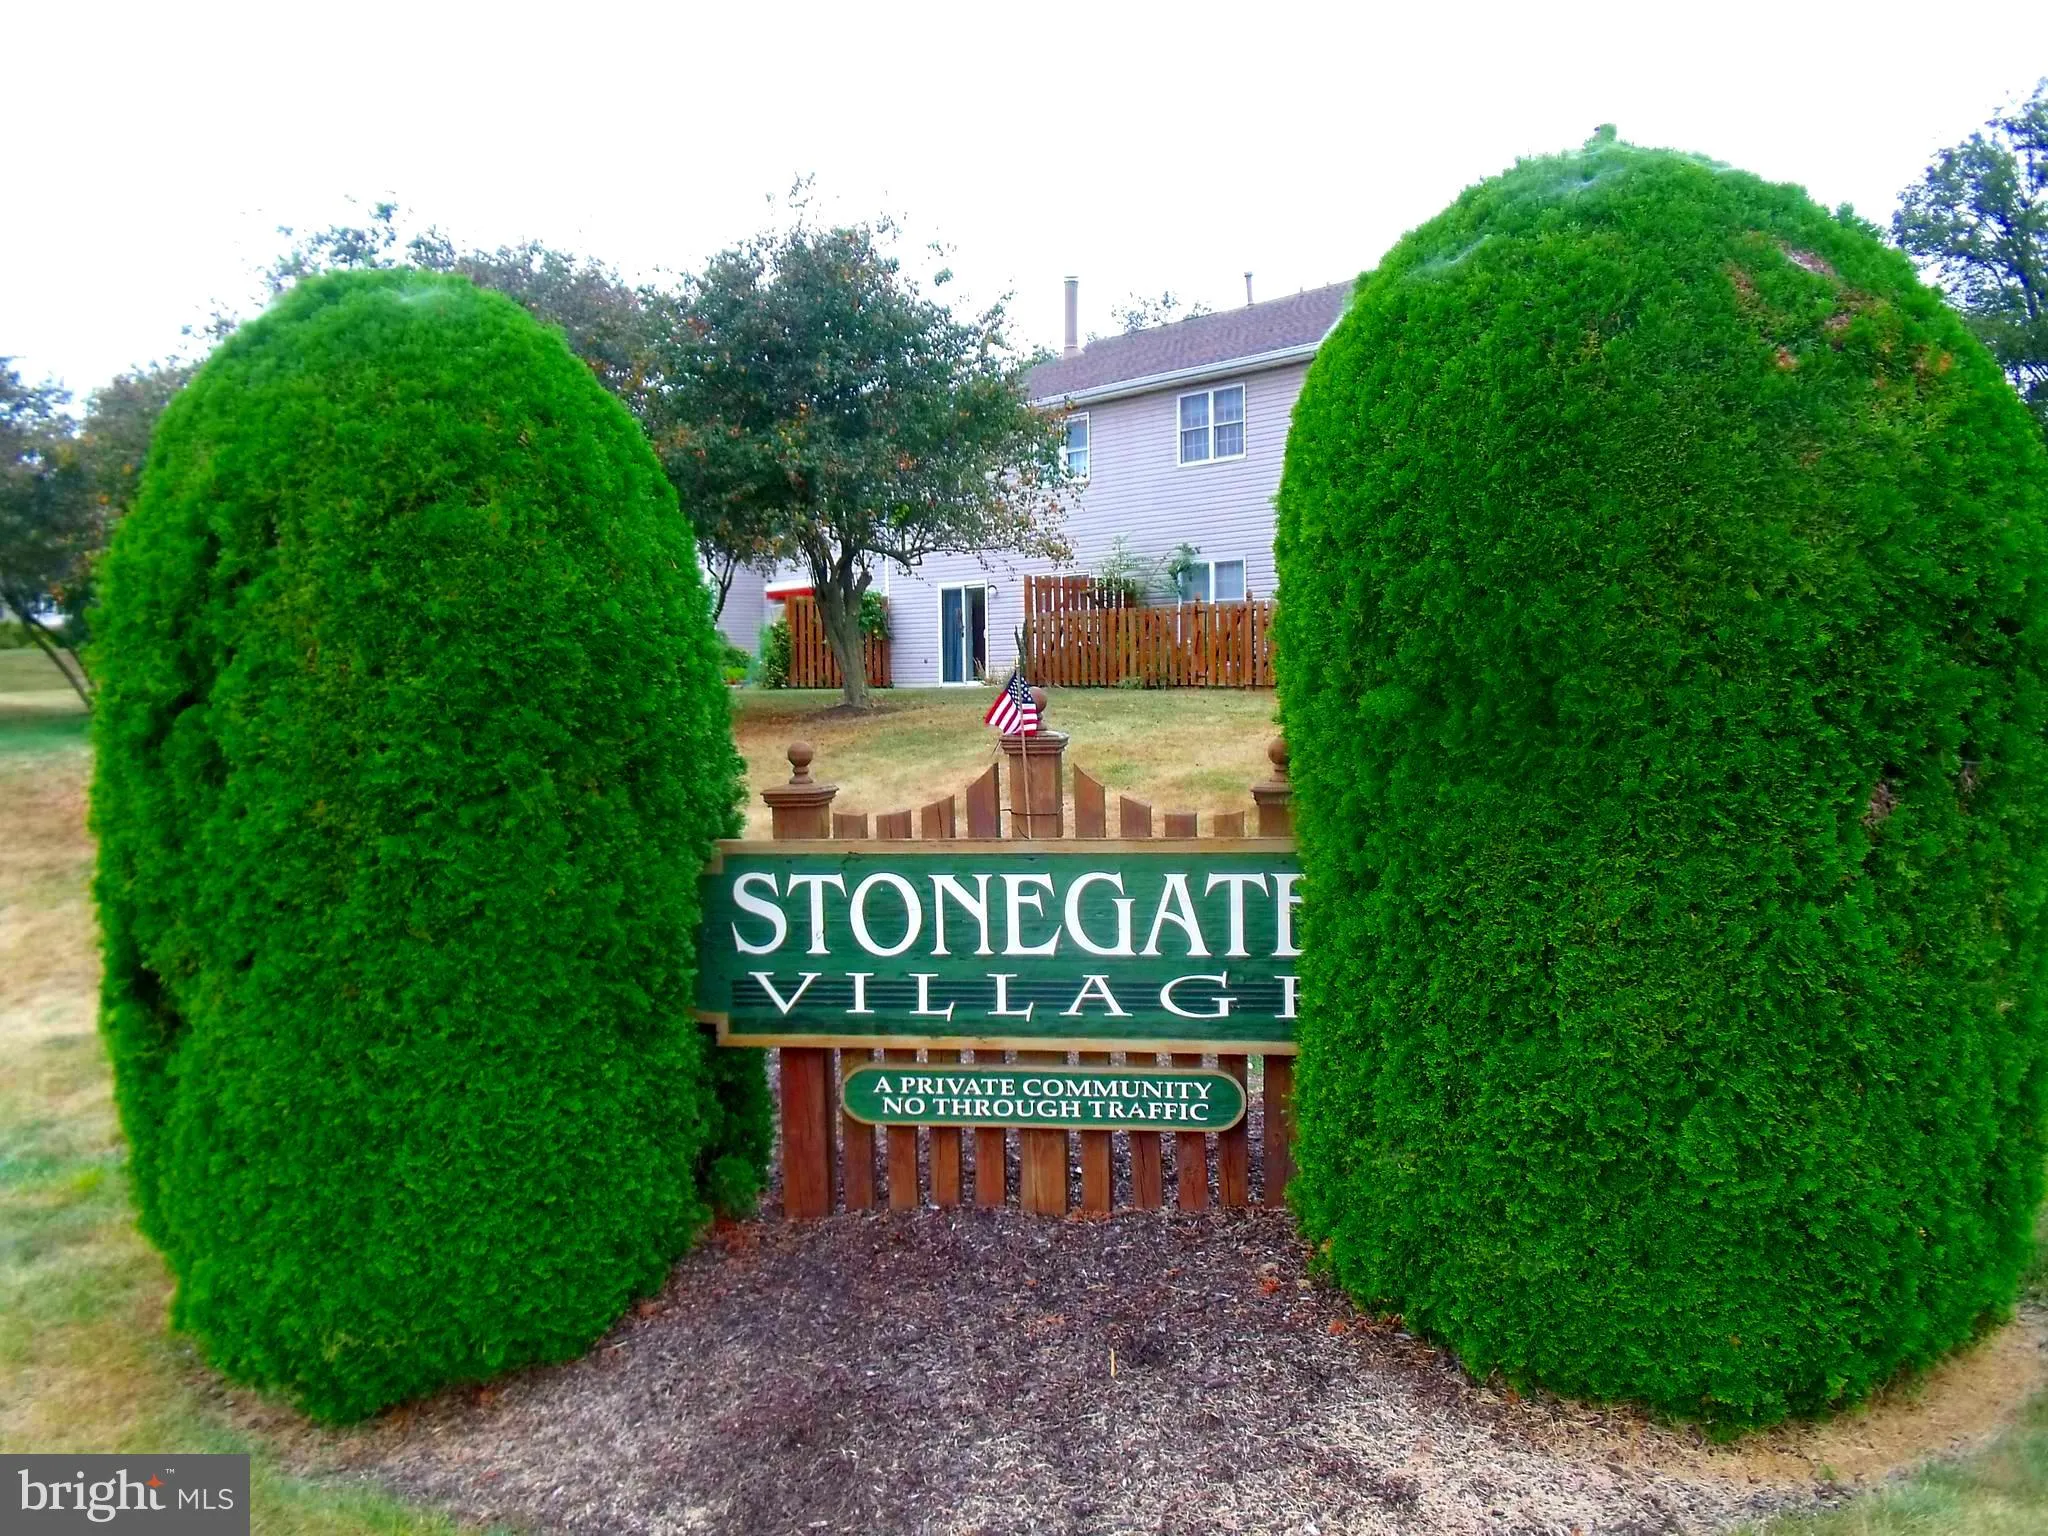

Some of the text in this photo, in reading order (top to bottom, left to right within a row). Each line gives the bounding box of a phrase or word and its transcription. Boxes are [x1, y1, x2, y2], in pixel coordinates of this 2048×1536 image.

[731, 871, 1306, 957] STONEGATE
[873, 1075, 1213, 1100] A PRIVATE COMMUNITY
[882, 1096, 1210, 1121] NO THROUGH TRAFFIC
